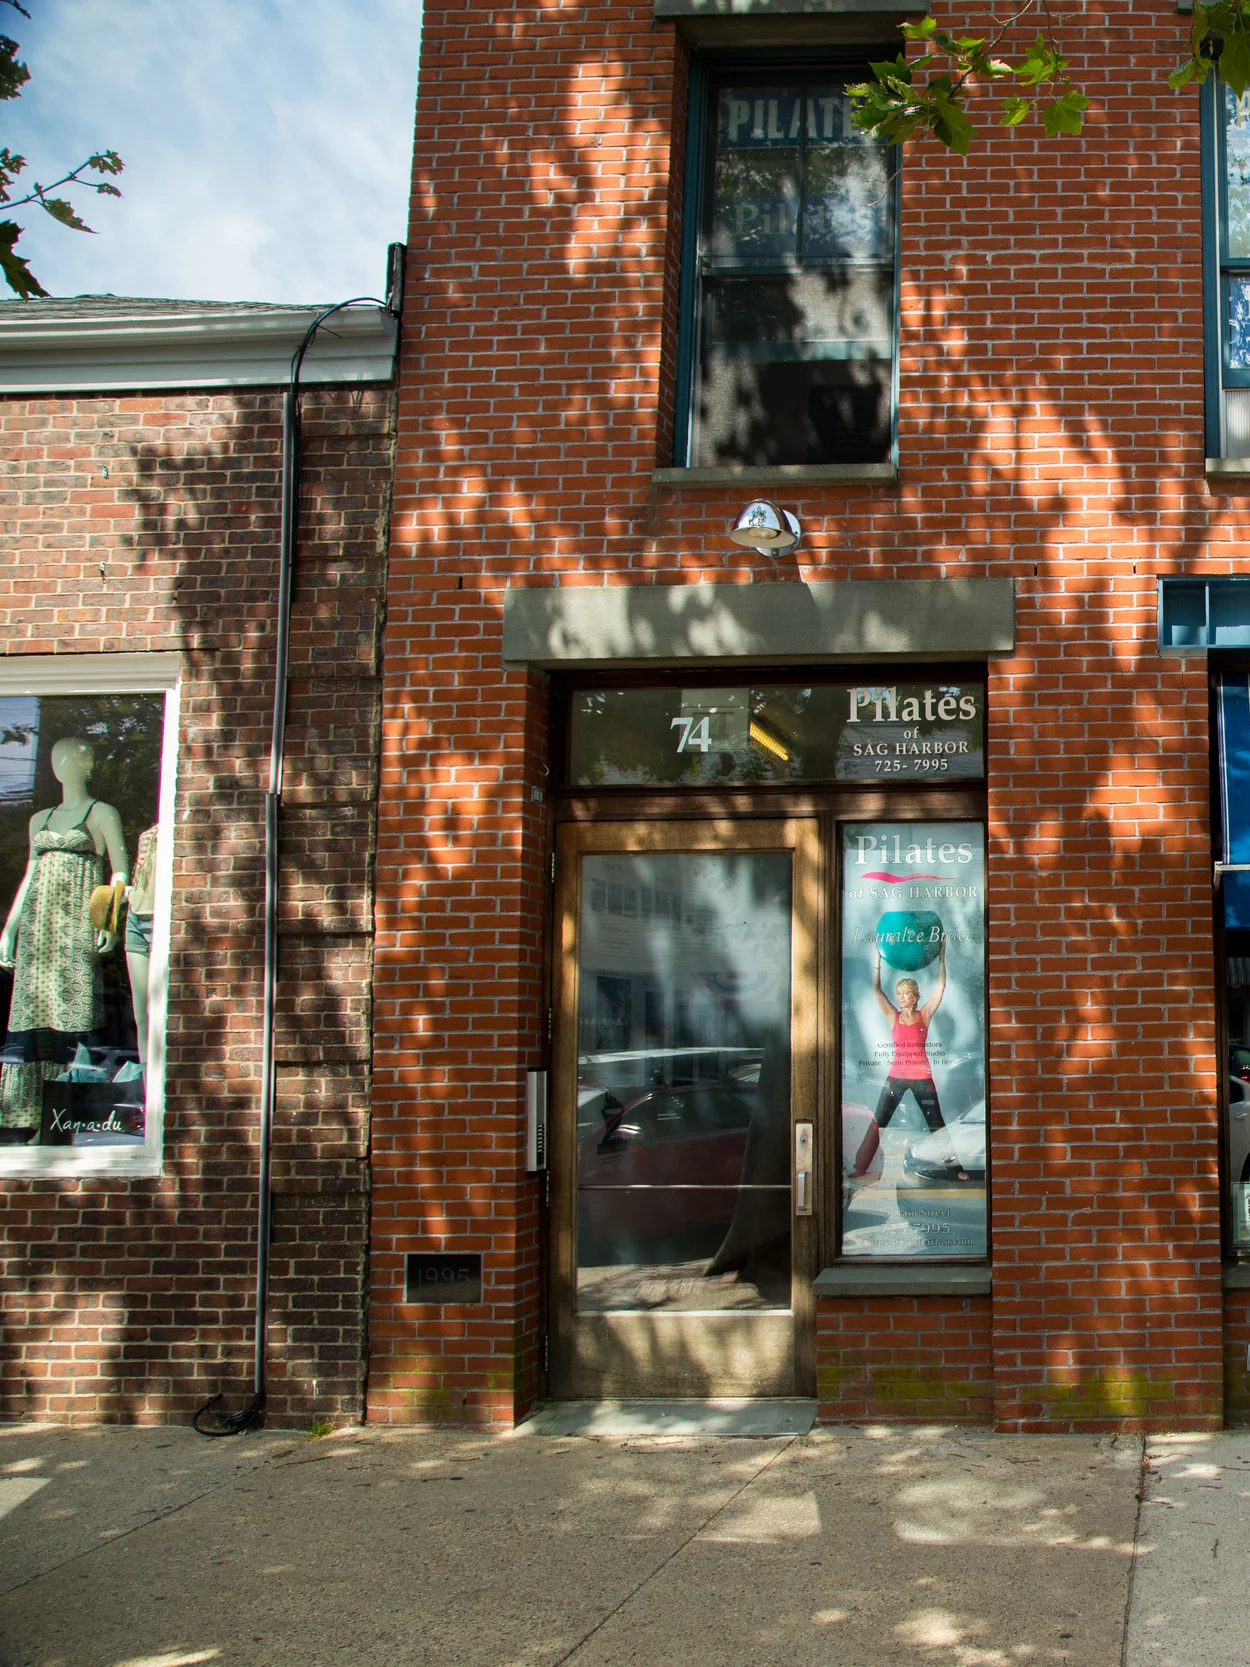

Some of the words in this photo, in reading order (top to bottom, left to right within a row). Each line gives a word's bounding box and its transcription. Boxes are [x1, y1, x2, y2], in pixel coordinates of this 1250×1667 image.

[727, 97, 880, 142] PILATE
[846, 686, 978, 724] Pilates
[670, 716, 712, 753] 74
[903, 726, 919, 740] of
[853, 743, 889, 757] SAG
[895, 740, 970, 756] HARBOR
[914, 758, 949, 772] 7995
[854, 833, 974, 865] Pilates
[849, 886, 864, 899] of
[869, 886, 903, 899] SAG
[908, 885, 978, 898] HARBOR
[912, 1222, 951, 1235] 7995
[418, 1267, 471, 1289] 1995
